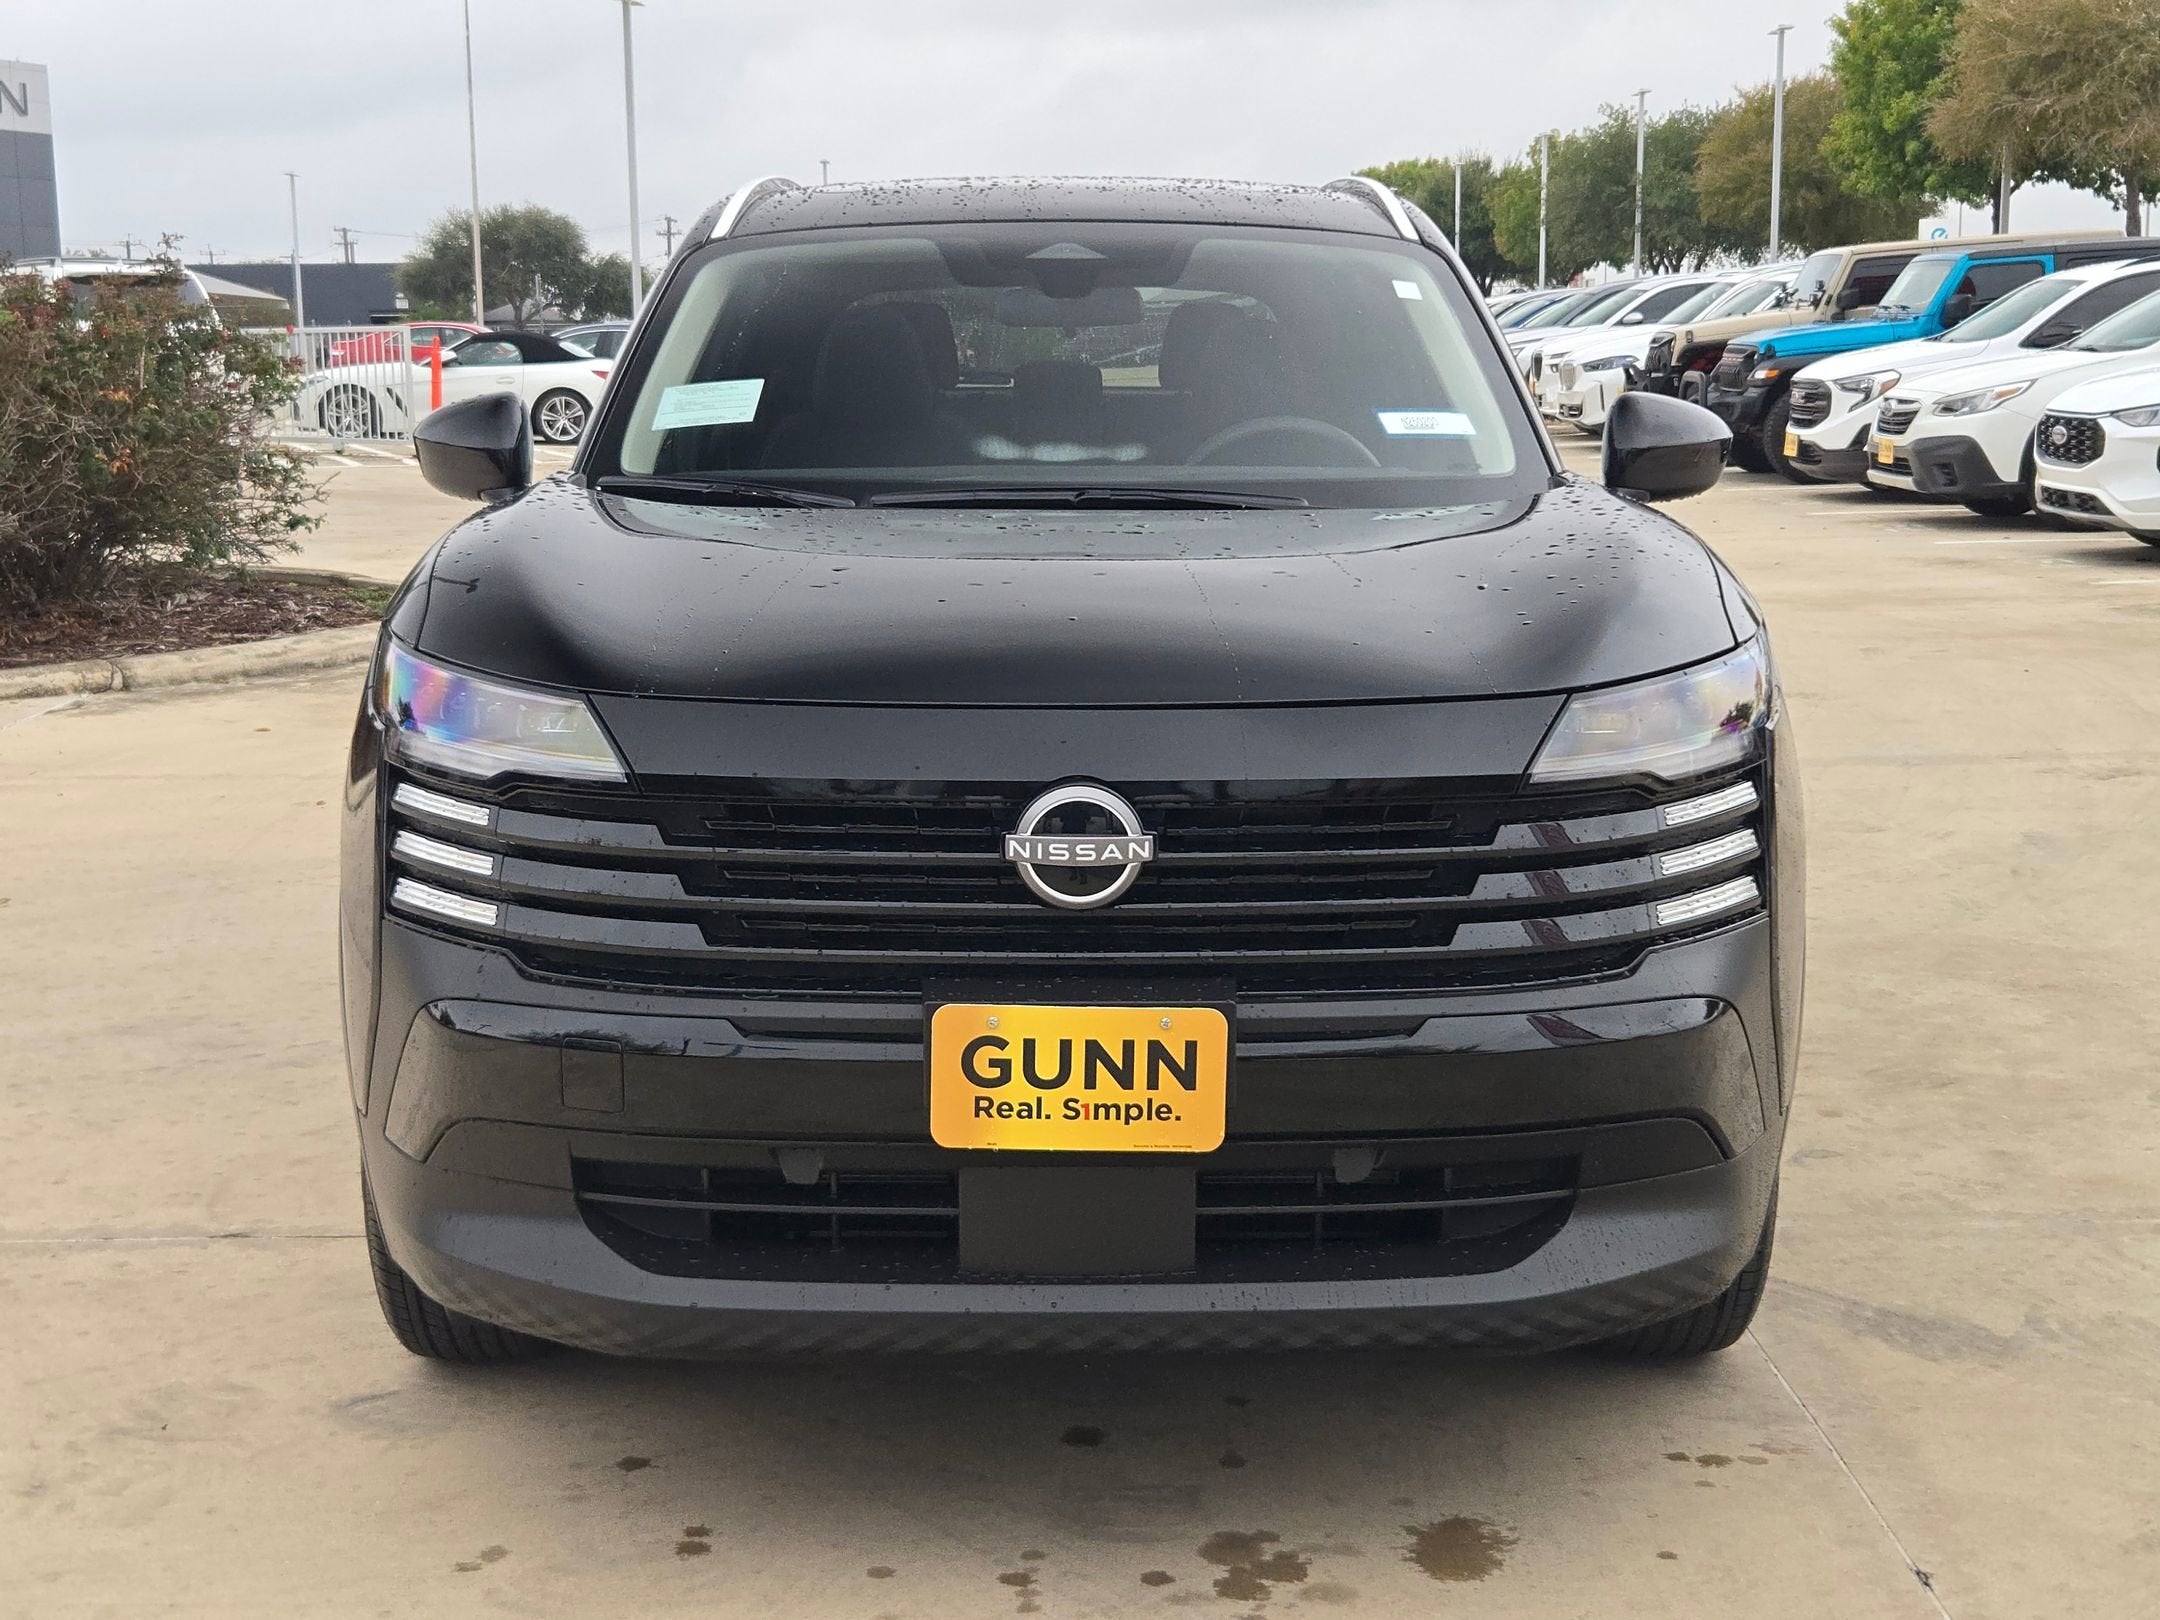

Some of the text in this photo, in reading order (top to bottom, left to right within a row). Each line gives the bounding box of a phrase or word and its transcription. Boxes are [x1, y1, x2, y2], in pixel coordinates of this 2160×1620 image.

[1007, 839, 1151, 862] NISSAN
[961, 1035, 1198, 1091] GUNN
[974, 1096, 1051, 1120] Real.
